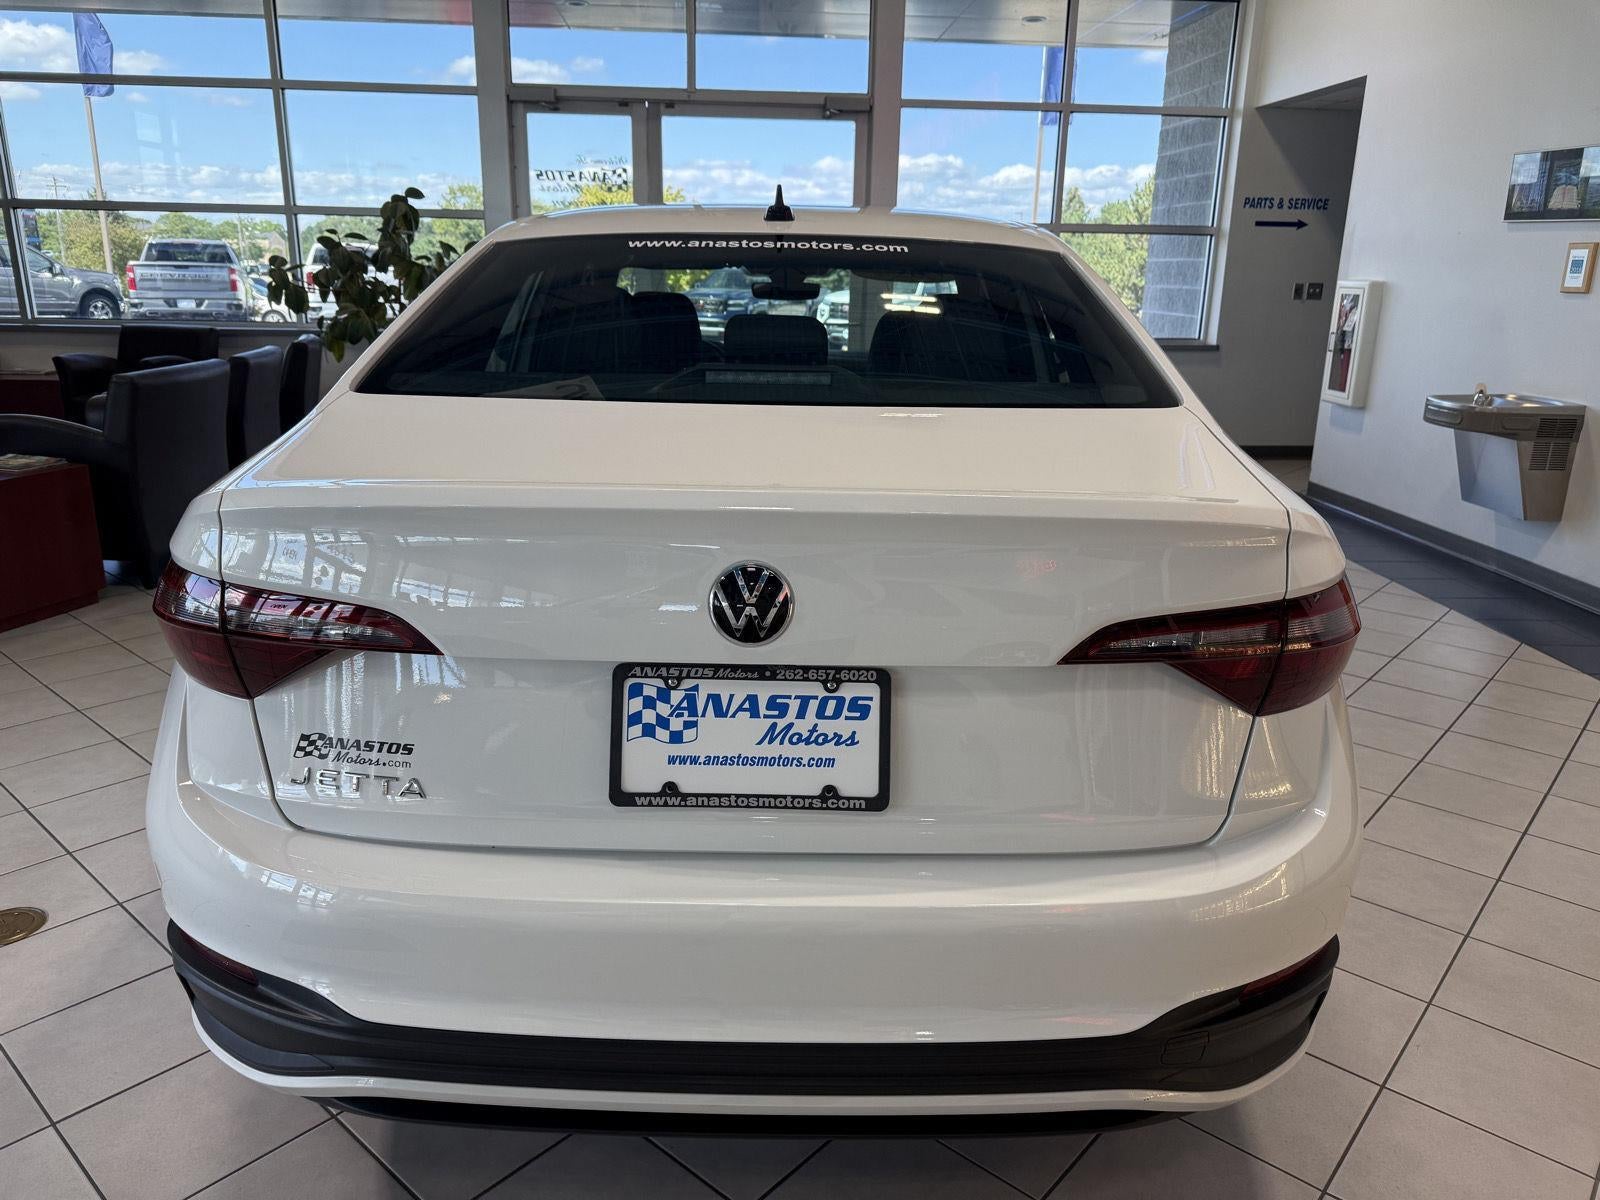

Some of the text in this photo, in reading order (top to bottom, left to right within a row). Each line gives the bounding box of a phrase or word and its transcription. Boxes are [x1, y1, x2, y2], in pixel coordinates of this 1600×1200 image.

[1243, 197, 1330, 210] PARTS & SERVICE
[628, 239, 909, 253] www.anastosmotors.com
[628, 666, 877, 681] ANASTOS Motors 262-657-6020
[667, 691, 874, 721] ANASTOS
[755, 721, 860, 747] Motors
[320, 736, 415, 755] ANASTOS
[331, 751, 412, 769] Motors.com
[667, 753, 836, 768] www.anastosmotors.com
[290, 766, 427, 799] JETTA
[635, 794, 867, 809] www.anastosmotors.com
